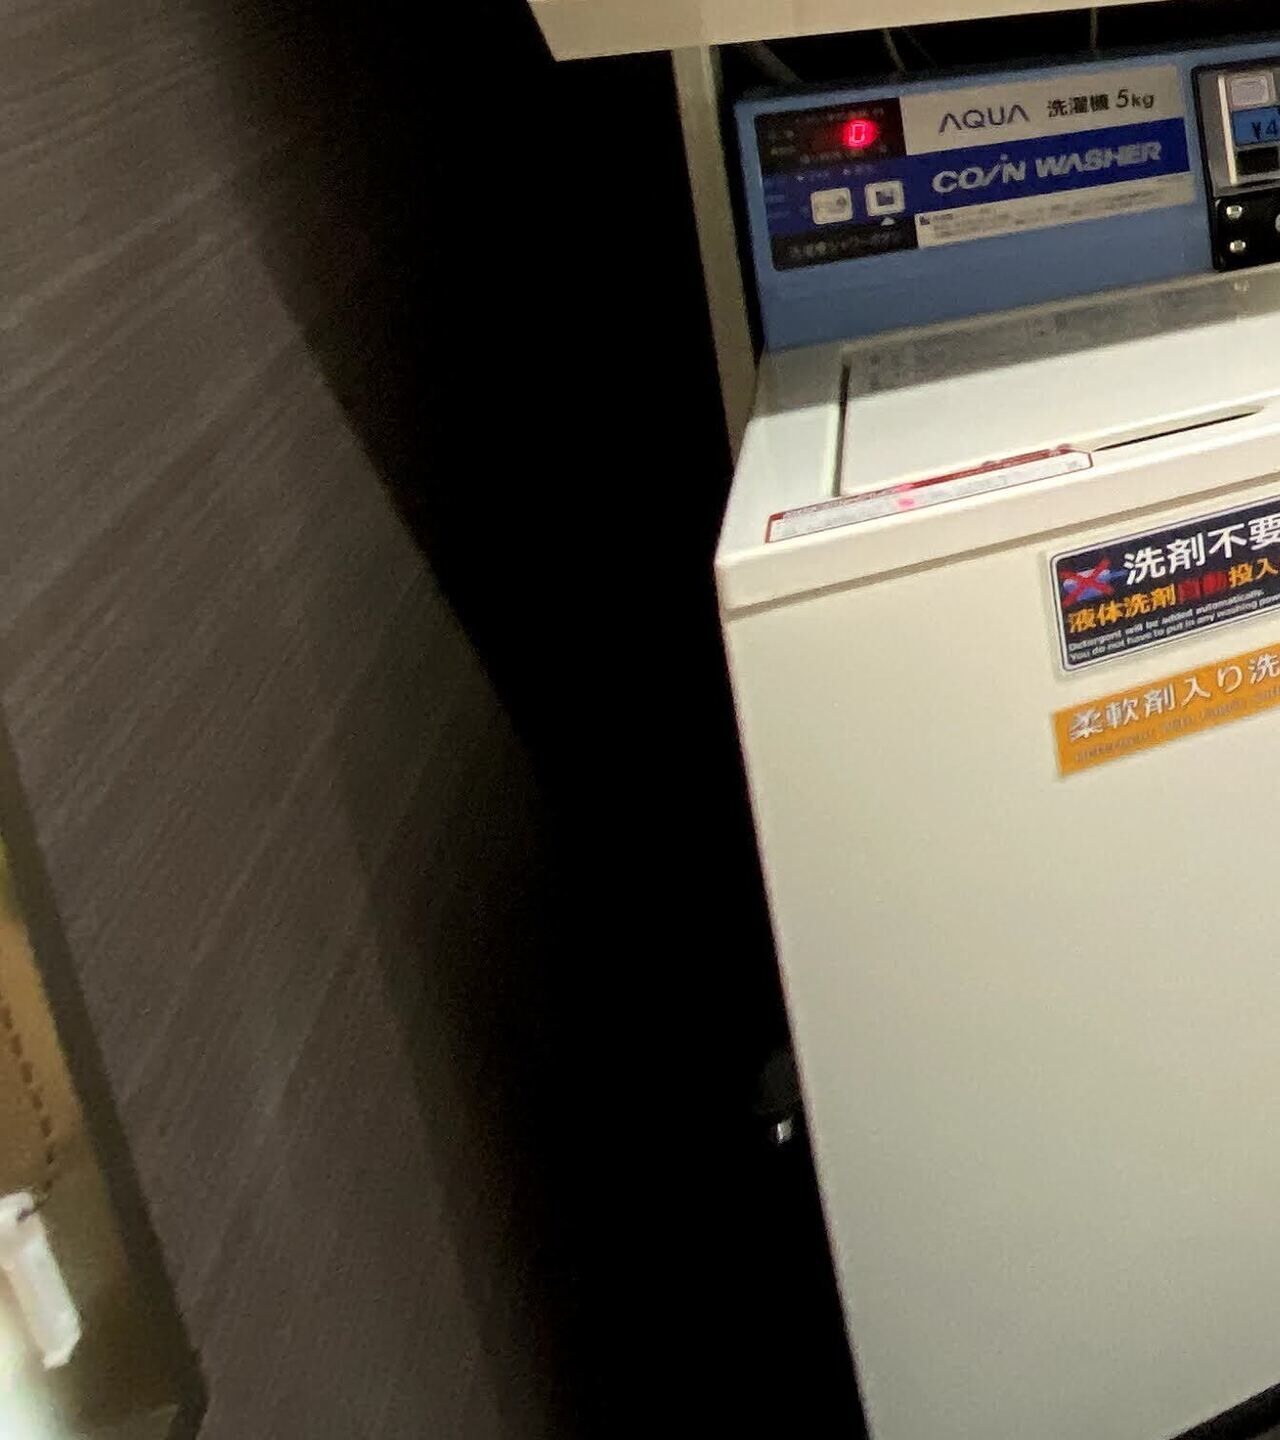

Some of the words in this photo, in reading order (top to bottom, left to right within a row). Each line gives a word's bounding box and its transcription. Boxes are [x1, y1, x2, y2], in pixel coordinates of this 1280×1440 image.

[849, 122, 866, 145] 0
[937, 103, 1030, 136] AQUA
[1046, 93, 1110, 119] 洗濯機
[1115, 88, 1155, 110] 5kg
[931, 153, 1027, 194] COIN
[1035, 140, 1162, 179] WASHER
[1069, 649, 1089, 662] You
[1091, 644, 1106, 655] do
[1108, 639, 1126, 652] not
[1127, 631, 1152, 647] have
[1153, 626, 1165, 638] to
[1165, 620, 1185, 637] put
